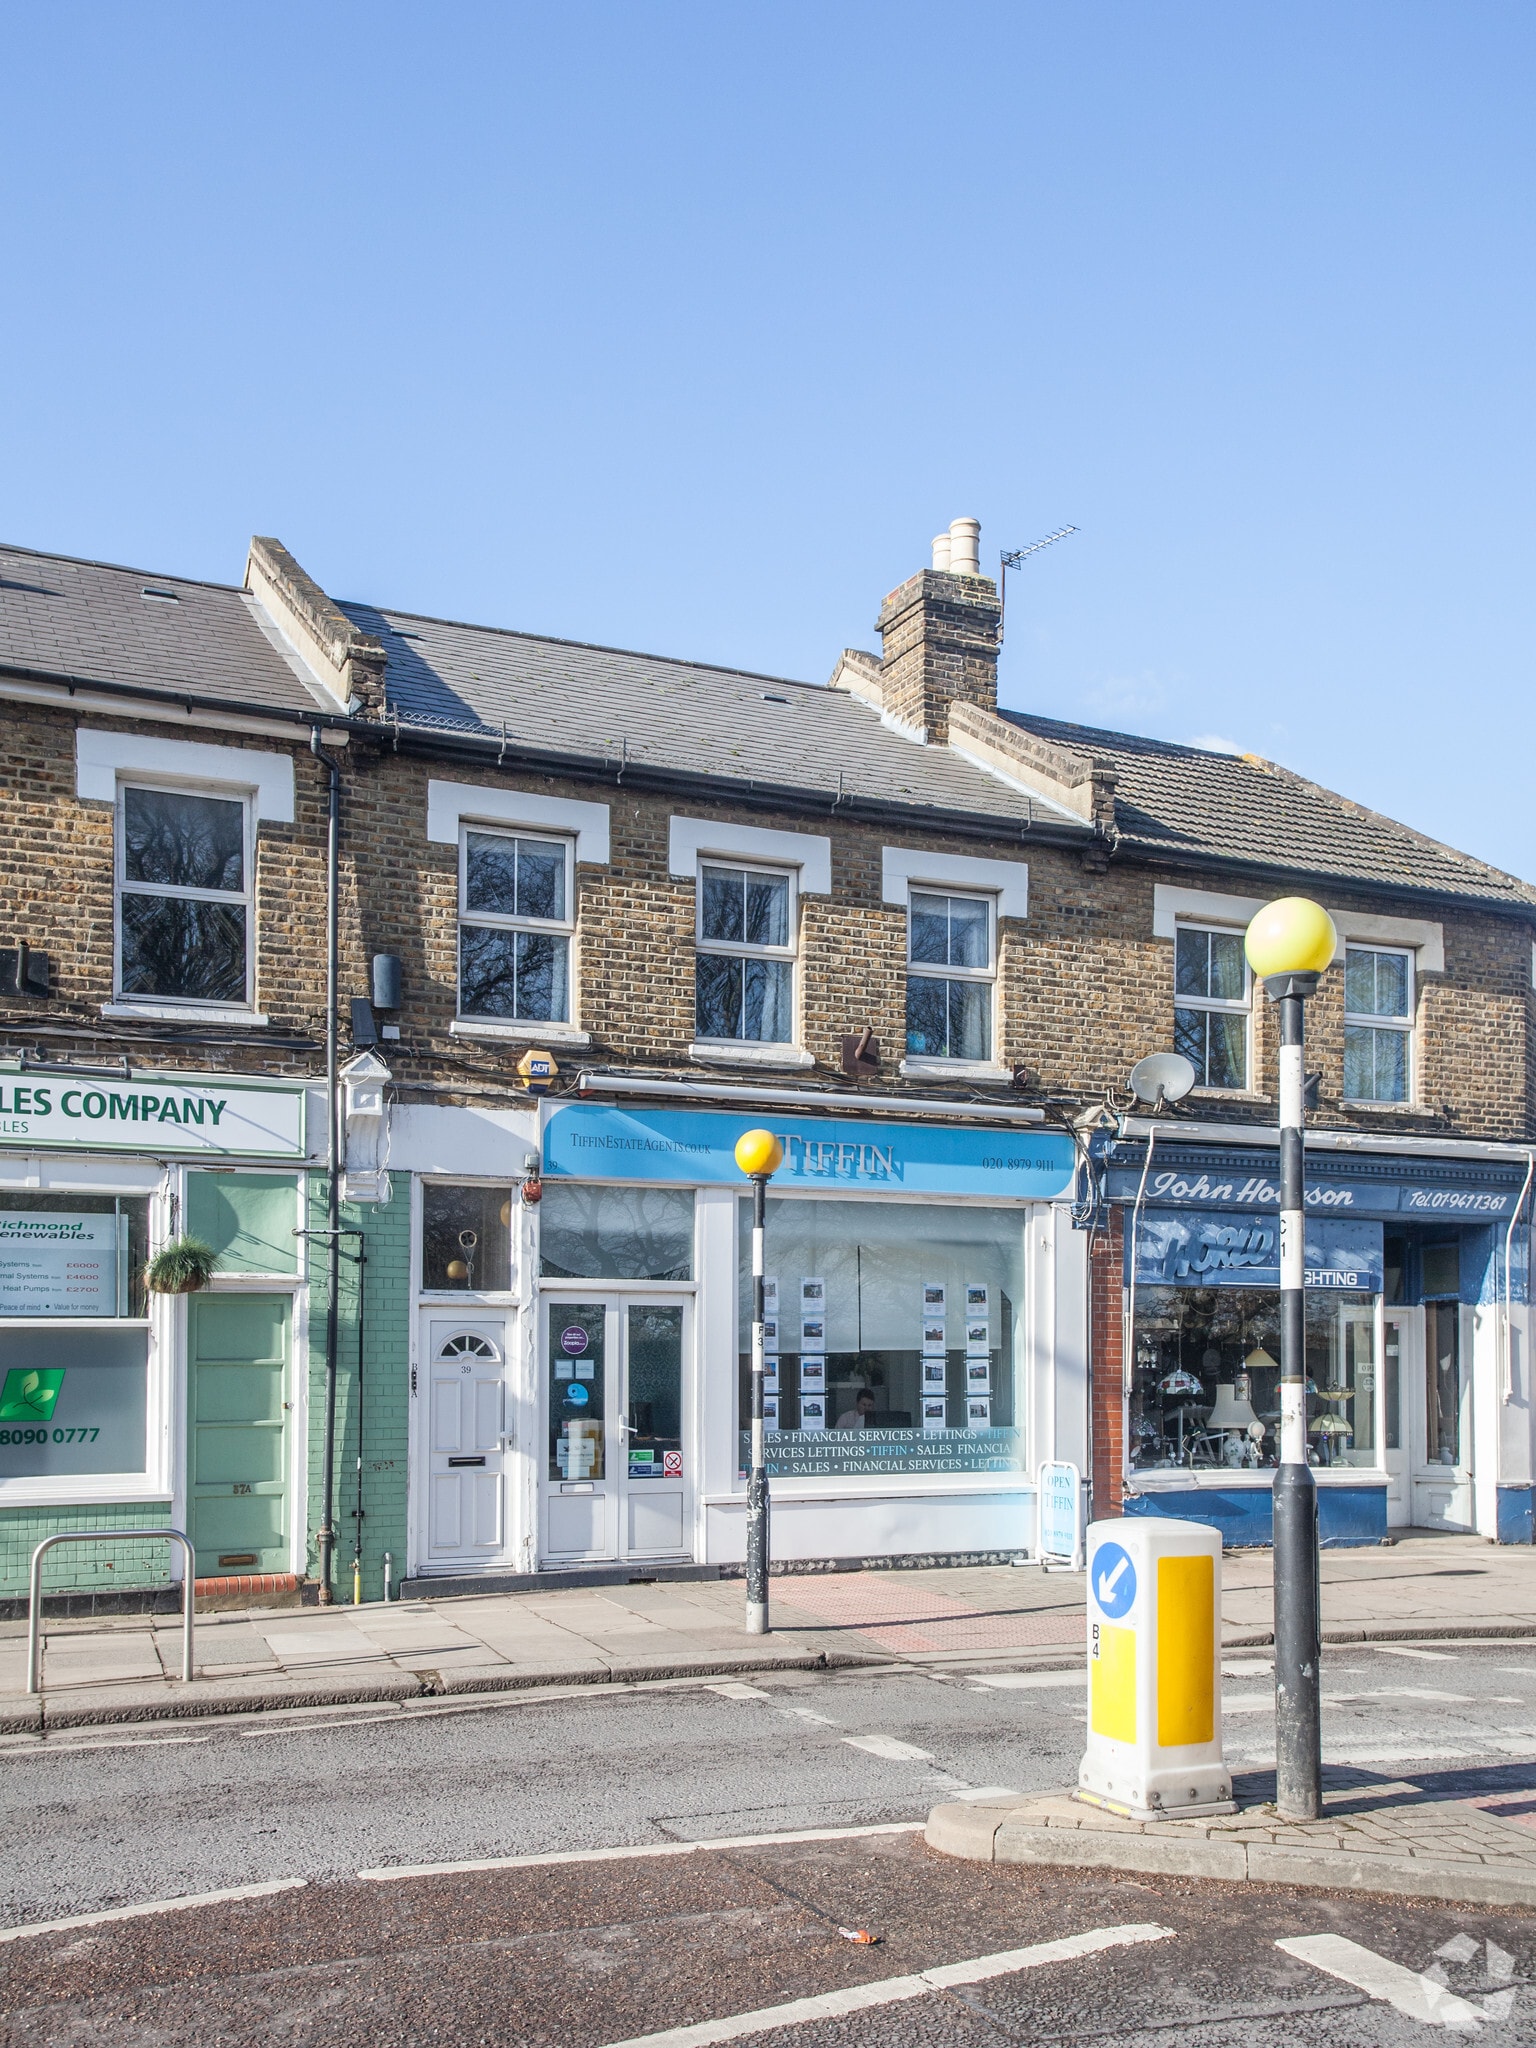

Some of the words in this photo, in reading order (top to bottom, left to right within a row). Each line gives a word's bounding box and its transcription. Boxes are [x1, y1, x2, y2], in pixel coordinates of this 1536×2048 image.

[531, 1063, 550, 1073] ADT
[61, 1090, 228, 1125] COMPANY
[0, 1120, 29, 1133] LES
[775, 1133, 894, 1174] TIFFIN
[547, 1161, 558, 1171] 39
[982, 1157, 1003, 1169] 020
[1007, 1158, 1032, 1170] 8979
[1035, 1159, 1054, 1171] 9111
[1145, 1172, 1232, 1200] John
[1235, 1178, 1354, 1206] Hoson
[0, 1221, 83, 1231] ichmond
[1162, 1226, 1274, 1278] WORLD
[1304, 1272, 1358, 1286] GHTING
[758, 1338, 764, 1346] 3
[412, 1363, 418, 1371] B
[461, 1366, 472, 1374] 39
[411, 1390, 418, 1398] A
[0, 1429, 48, 1445] 8090
[52, 1428, 100, 1443] 0777
[743, 1432, 781, 1443] SES
[791, 1431, 857, 1442] FINANCIAL
[859, 1430, 913, 1441] SERVICES
[923, 1429, 977, 1440] LETTINGS
[748, 1447, 805, 1459] SRVICES
[808, 1446, 865, 1458] LETTINGS
[870, 1445, 907, 1456] TIFFIN
[917, 1444, 952, 1455] SALES
[741, 1463, 779, 1473] TIIN
[792, 1462, 830, 1473] SALES
[843, 1461, 907, 1472] FINANCIAL
[908, 1459, 962, 1470] SERVICES
[1047, 1476, 1071, 1488] OPEN
[1044, 1493, 1073, 1510] TIFFIN
[1092, 1624, 1100, 1640] B
[1092, 1643, 1099, 1658] 4
